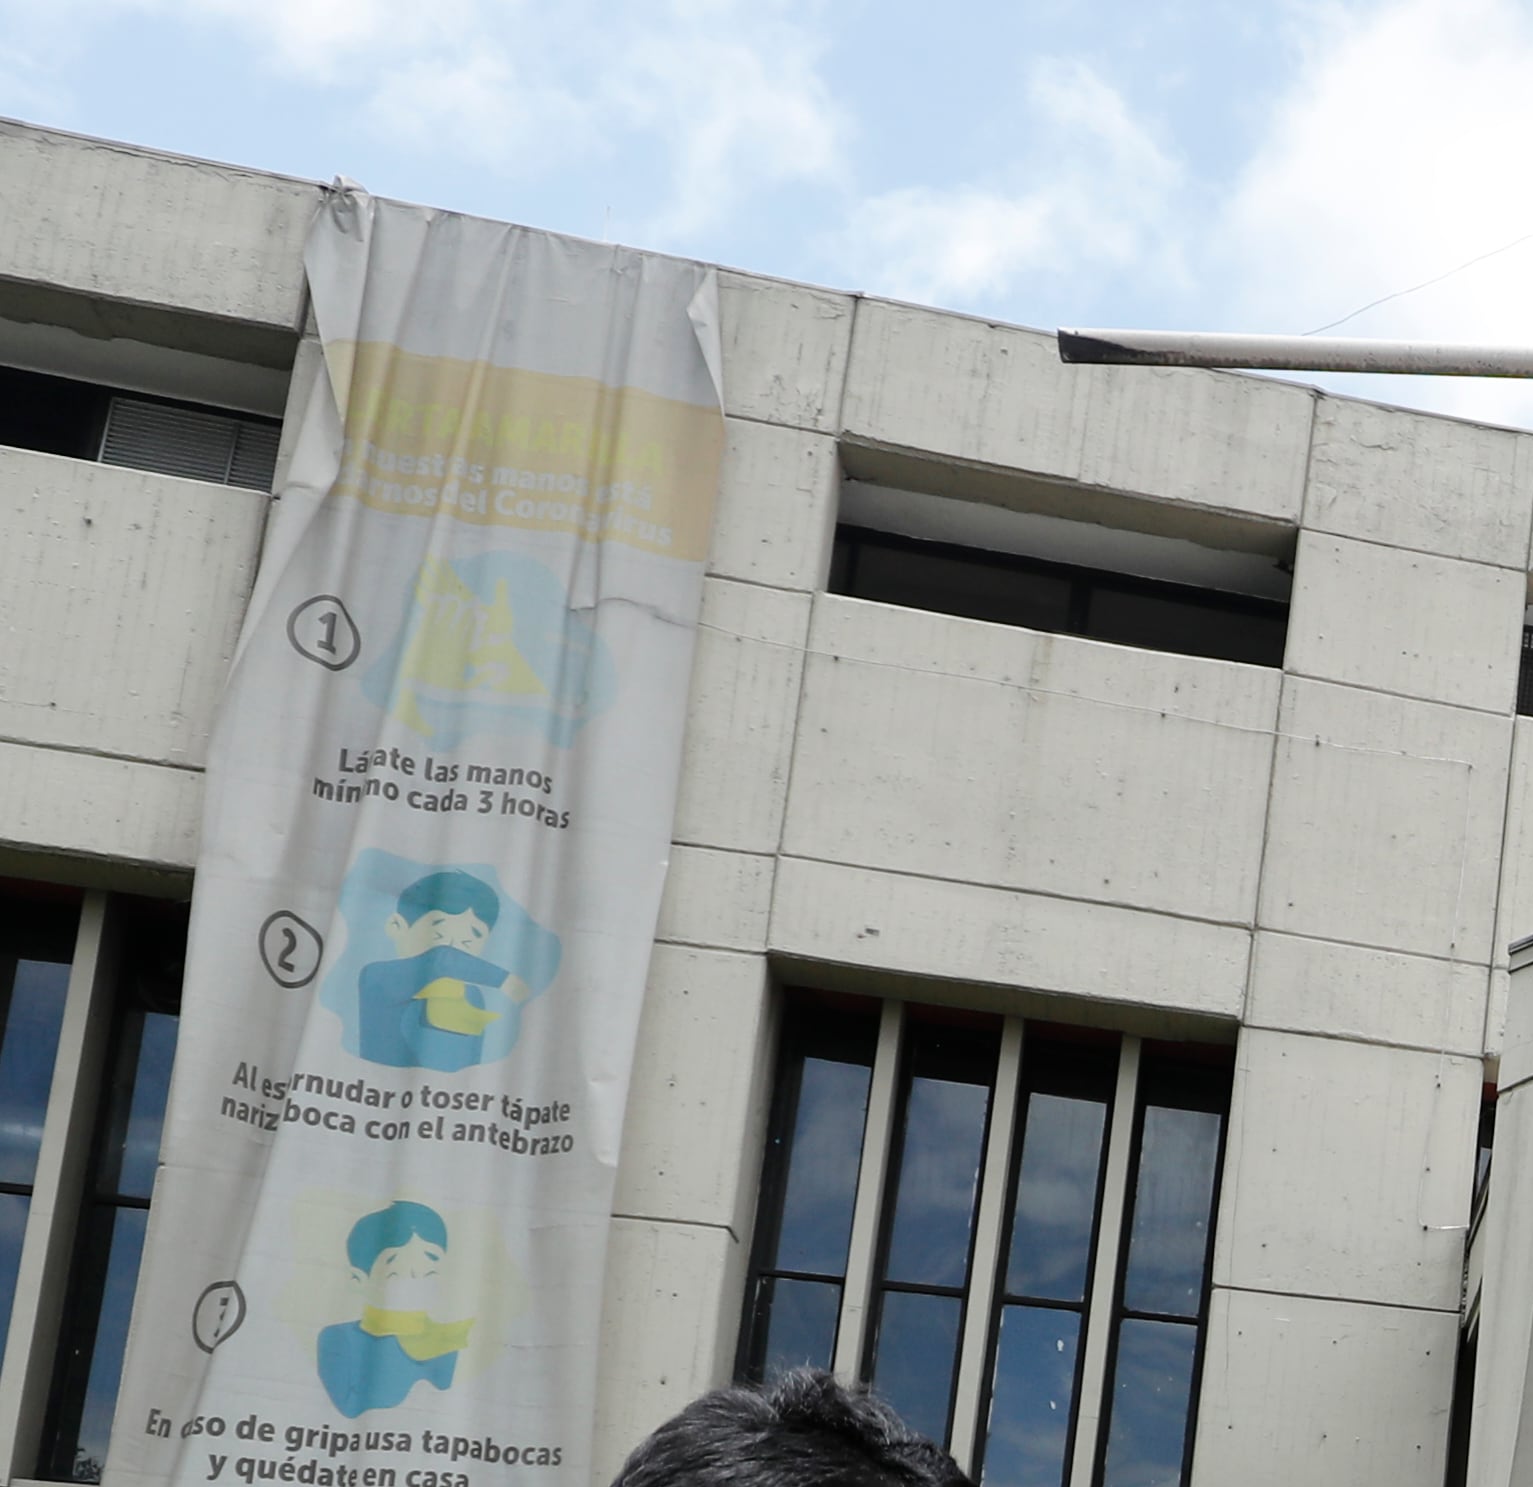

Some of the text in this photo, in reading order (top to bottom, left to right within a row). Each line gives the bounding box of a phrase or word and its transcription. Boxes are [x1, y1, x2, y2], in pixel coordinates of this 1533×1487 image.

[316, 611, 338, 655] 1
[424, 757, 459, 783] las
[465, 763, 552, 795] manos
[406, 789, 468, 812] cada
[478, 789, 494, 815] 3
[501, 791, 571, 830] horas
[278, 927, 297, 973] 2
[232, 1061, 259, 1092] Al
[400, 1088, 415, 1110] o
[420, 1084, 494, 1112] toser
[501, 1094, 571, 1131] tápate
[220, 1094, 574, 1156] nariz boca con el antebrazo
[144, 1407, 171, 1439] En
[235, 1412, 275, 1443] de
[284, 1423, 360, 1457] gripa
[364, 1429, 412, 1453] usa
[421, 1429, 563, 1467] tapabocas
[206, 1452, 228, 1481] y
[361, 1466, 396, 1487] en
